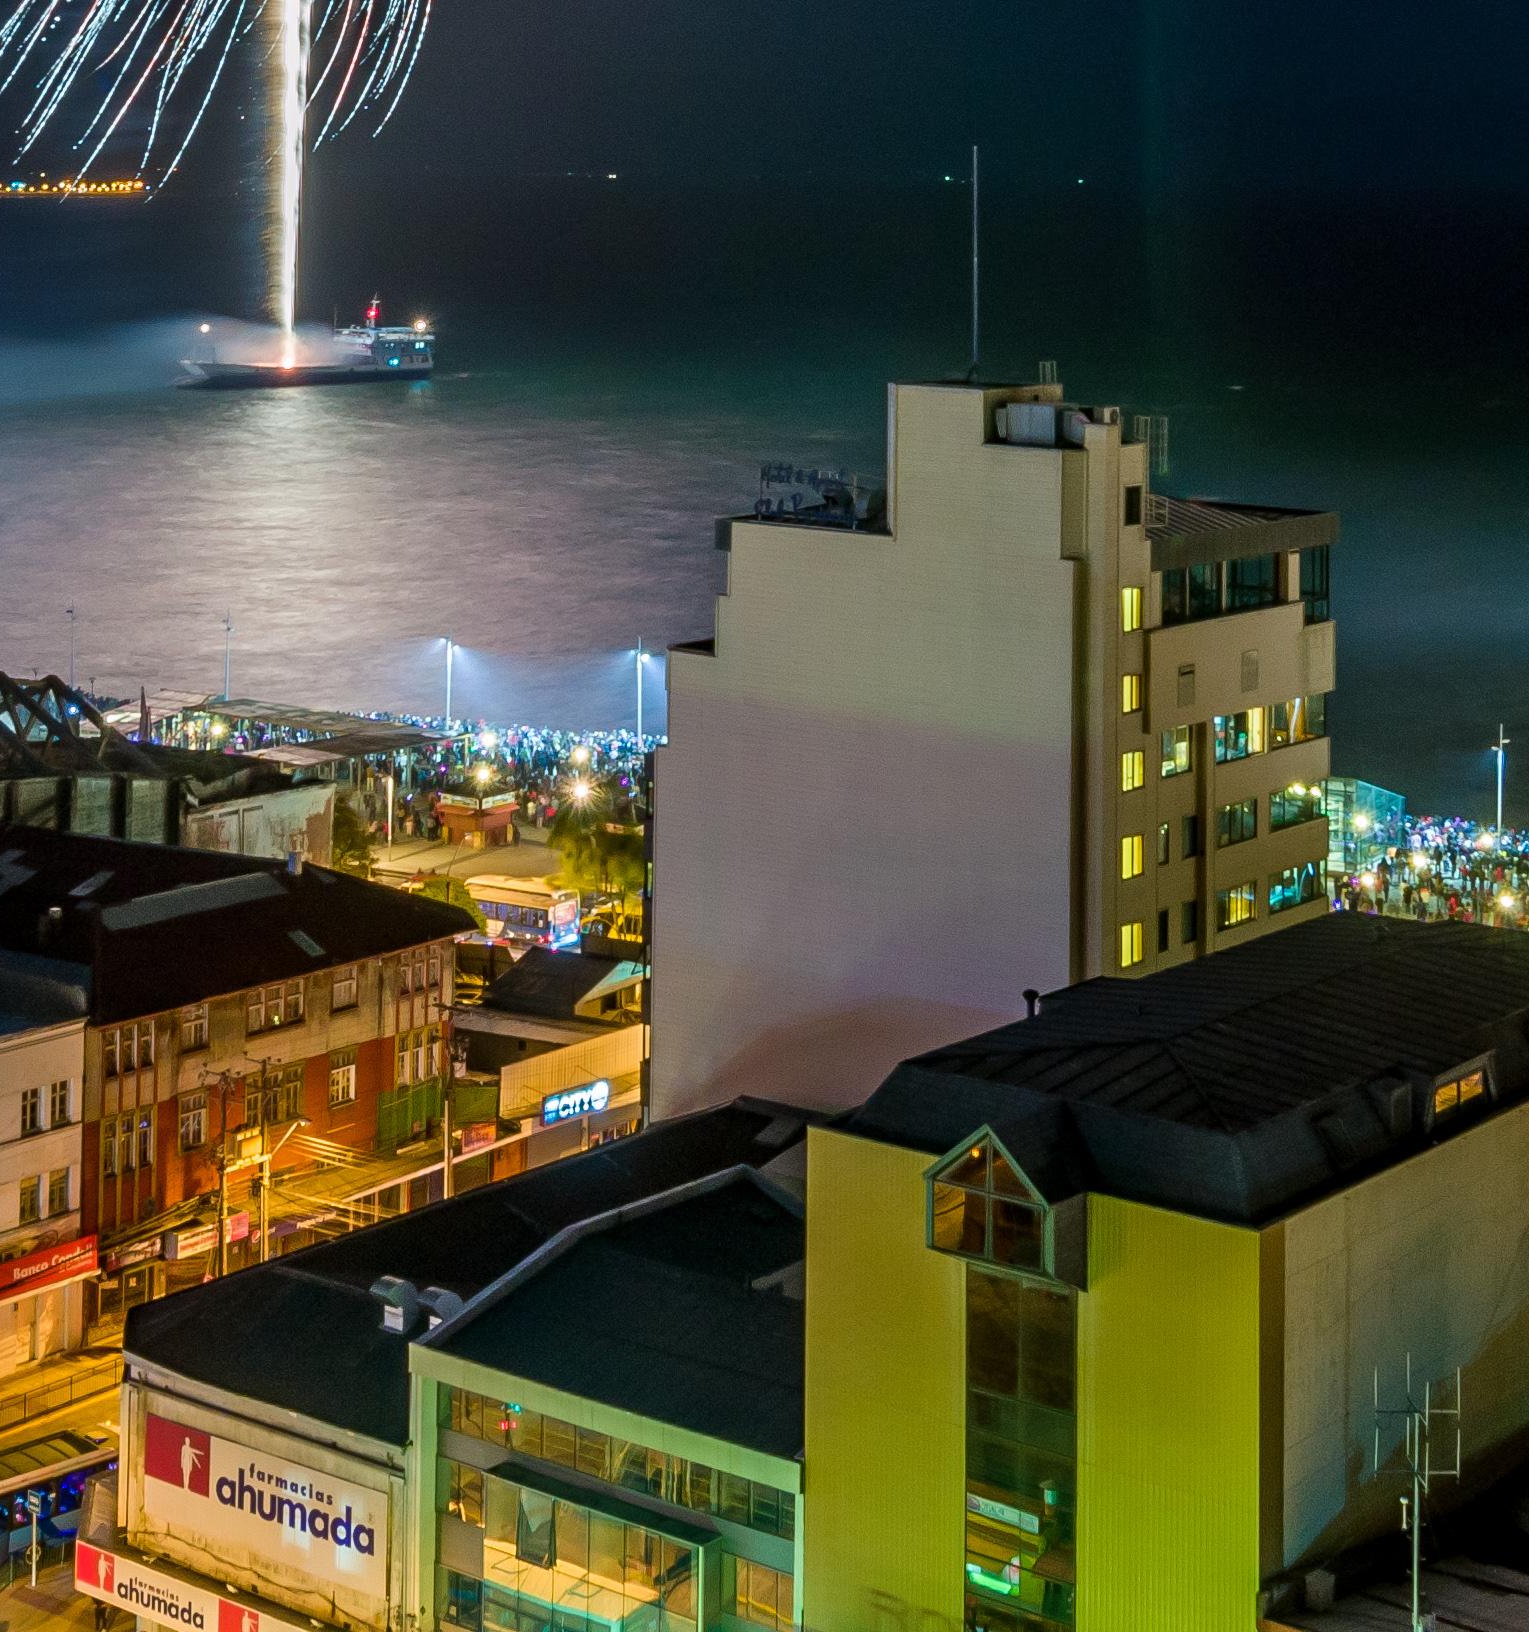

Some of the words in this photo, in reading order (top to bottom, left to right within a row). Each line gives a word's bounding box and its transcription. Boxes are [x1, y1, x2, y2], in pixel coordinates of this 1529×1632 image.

[13, 1262, 49, 1282] Banco
[249, 1463, 334, 1505] farmacias
[216, 1468, 375, 1556] ahumada
[117, 1577, 204, 1630] ahumada
[133, 1576, 179, 1602] farmacias
